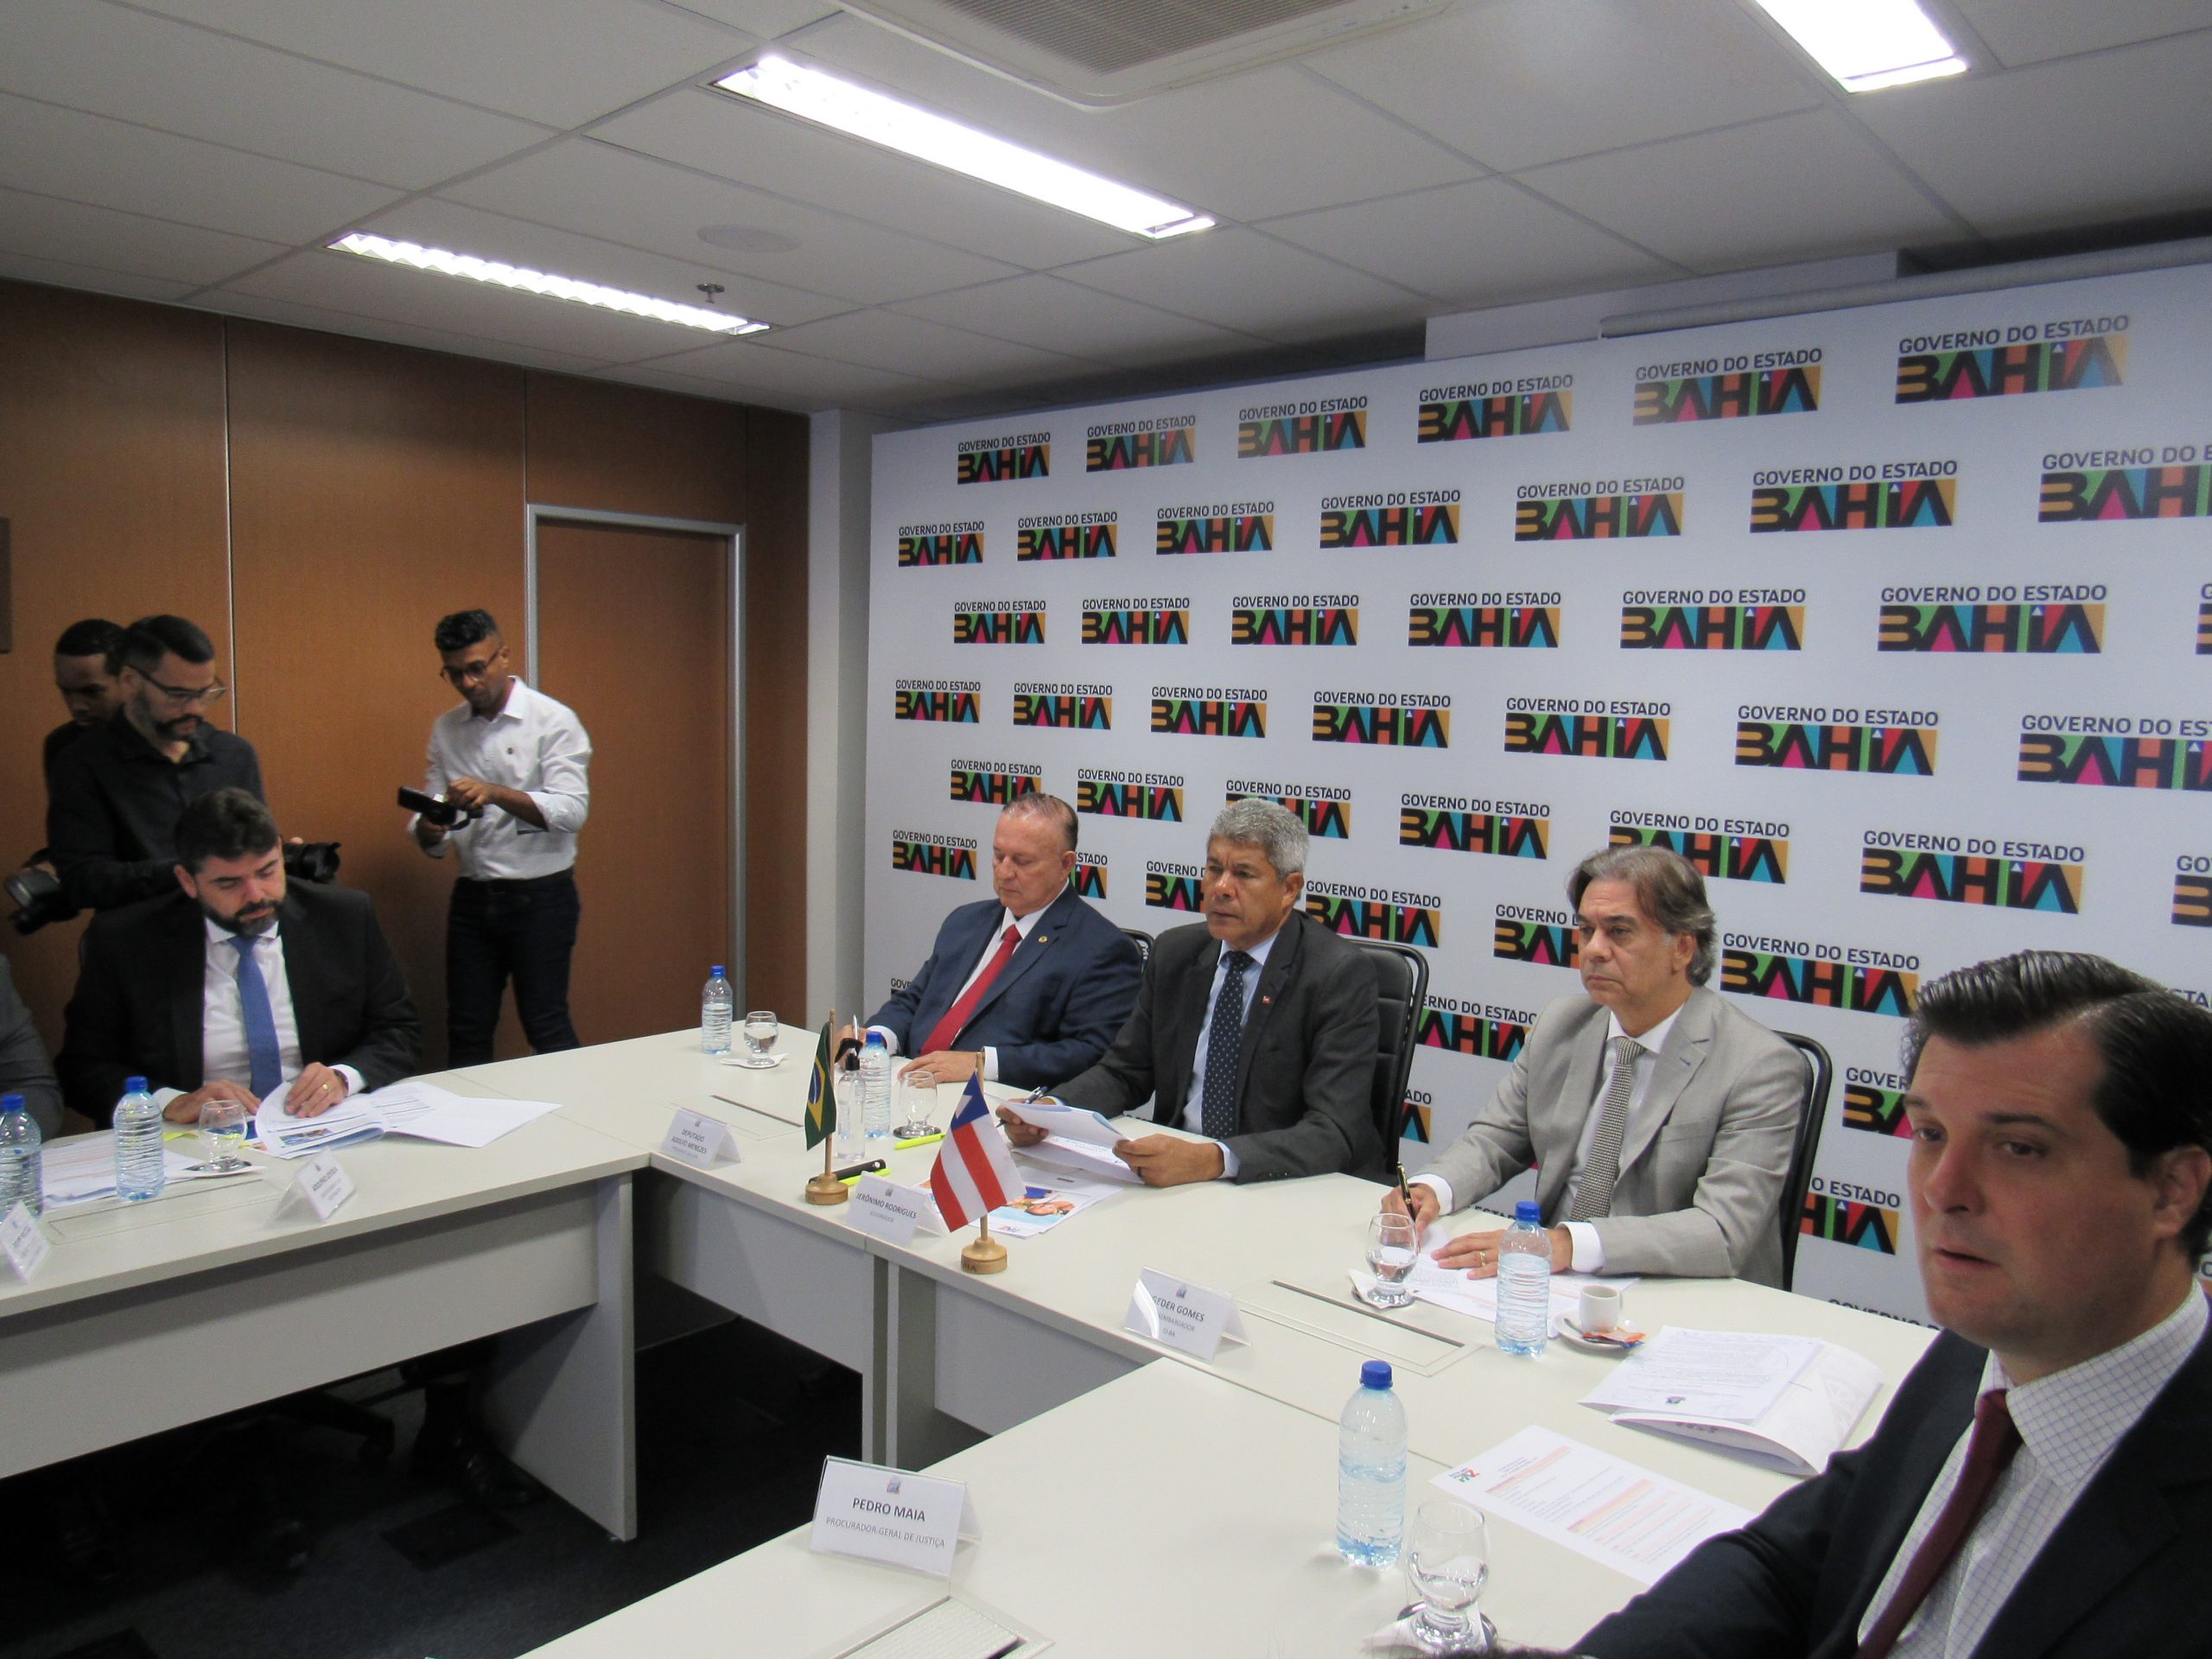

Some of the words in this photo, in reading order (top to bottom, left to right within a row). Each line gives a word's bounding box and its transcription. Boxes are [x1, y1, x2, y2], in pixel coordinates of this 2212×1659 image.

[1897, 327, 2000, 354] GOVERNO
[2005, 323, 2037, 343] DO
[2042, 314, 2129, 340] ESTADO
[1634, 357, 1718, 380] GOVERNO
[1721, 353, 1748, 372] DO
[1751, 346, 1822, 369] ESTADO
[1894, 334, 2127, 404] BAHIA
[1418, 382, 1488, 403] GOVERNO
[1491, 379, 1512, 396] DO
[1516, 372, 1573, 393] ESTADO
[1632, 365, 1821, 425] BAHIA
[1238, 404, 1297, 422] GOVERNO
[1299, 401, 1318, 416] DO
[1319, 395, 1368, 413] ESTADO
[1417, 390, 1573, 444] BAHIA
[1086, 422, 1136, 438] GOVERNO
[1138, 419, 1154, 433] DO
[1155, 415, 1197, 431] ESTADO
[1237, 410, 1368, 460] BAHIA
[957, 437, 1000, 453] GOVERNO
[1001, 435, 1014, 448] DO
[1015, 431, 1051, 446] ESTADO
[1086, 429, 1196, 473] BAHIA
[957, 444, 1051, 485] BAHIA
[1751, 466, 1844, 486] GOVERNO
[1847, 464, 1877, 481] DO
[1881, 459, 1958, 480] ESTADO
[2040, 448, 2155, 471] GOVERNO
[2159, 445, 2196, 464] DO
[1320, 494, 1383, 511] GOVERNO
[1386, 493, 1406, 507] DO
[1408, 489, 1461, 505] ESTADO
[1516, 480, 1592, 499] GOVERNO
[1594, 480, 1618, 495] DO
[1622, 475, 1685, 493] ESTADO
[1017, 515, 1063, 529] GOVERNO
[1065, 513, 1079, 526] DO
[1080, 511, 1118, 524] ESTADO
[1156, 505, 1210, 520] GOVERNO
[1211, 504, 1229, 517] DO
[1230, 501, 1274, 516] ESTADO
[1515, 493, 1684, 542] BAHIA
[1750, 478, 1957, 533] BAHIA
[897, 523, 937, 536] GOVERNO
[938, 522, 950, 533] DO
[952, 520, 984, 532] ESTADO
[1156, 515, 1274, 556] BAHIA
[1319, 505, 1460, 550] BAHIA
[897, 532, 984, 567] BAHIA
[1017, 524, 1117, 562] BAHIA
[953, 601, 995, 612] GOVERNO
[997, 600, 1010, 611] DO
[1012, 600, 1046, 611] ESTADO
[1082, 598, 1131, 610] GOVERNO
[1132, 598, 1148, 609] DO
[1150, 597, 1190, 609] ESTADO
[1231, 595, 1289, 608] GOVERNO
[1292, 594, 1310, 607] DO
[1312, 594, 1360, 607] ESTADO
[1409, 592, 1478, 607] GOVERNO
[1480, 592, 1502, 606] DO
[1505, 591, 1562, 606] ESTADO
[1622, 588, 1705, 604] GOVERNO
[1707, 588, 1734, 604] DO
[1738, 588, 1807, 603] ESTADO
[1879, 585, 1981, 602] GOVERNO
[1986, 585, 2018, 601] DO
[2022, 583, 2107, 601] ESTADO
[953, 612, 1046, 644] BAHIA
[1081, 611, 1190, 645] BAHIA
[1231, 609, 1359, 646] BAHIA
[1408, 607, 1561, 648] BAHIA
[1620, 606, 1806, 650] BAHIA
[1878, 604, 2106, 653] BAHIA
[894, 678, 934, 690] GOVERNO
[935, 679, 947, 690] DO
[949, 680, 981, 691] ESTADO
[1013, 682, 1058, 694] GOVERNO
[1059, 683, 1074, 695] DO
[1076, 683, 1113, 696] ESTADO
[1151, 686, 1204, 699] GOVERNO
[1205, 687, 1222, 700] DO
[1224, 688, 1268, 702] ESTADO
[894, 690, 981, 723] BAHIA
[1013, 694, 1113, 730] BAHIA
[1313, 690, 1375, 705] GOVERNO
[1377, 693, 1397, 706] DO
[1400, 693, 1452, 709] ESTADO
[1505, 696, 1580, 713] GOVERNO
[1582, 699, 1606, 714] DO
[1609, 700, 1671, 716] ESTADO
[1150, 699, 1268, 739] BAHIA
[1312, 705, 1451, 748] BAHIA
[1737, 704, 1827, 722] GOVERNO
[1831, 707, 1859, 724] DO
[1864, 709, 1940, 727] ESTADO
[2020, 714, 2132, 734] GOVERNO
[2137, 717, 2172, 736] DO
[1503, 713, 1670, 761] BAHIA
[1735, 721, 1938, 776] BAHIA
[950, 758, 992, 772] GOVERNO
[993, 761, 1007, 772] DO
[1007, 762, 1042, 776] ESTADO
[1077, 767, 1126, 783] GOVERNO
[1127, 772, 1142, 784] DO
[1144, 772, 1185, 787] ESTADO
[1077, 780, 1184, 823] BAHIA
[1225, 779, 1282, 796] GOVERNO
[1284, 784, 1302, 798] DO
[1304, 785, 1351, 802] ESTADO
[1400, 792, 1467, 811] GOVERNO
[1470, 798, 1491, 813] DO
[1494, 800, 1550, 818] ESTADO
[1399, 808, 1549, 860] BAHIA
[1609, 809, 1690, 830] GOVERNO
[1694, 816, 1719, 832] DO
[1723, 818, 1790, 838] ESTADO
[892, 828, 931, 843] GOVERNO
[932, 833, 944, 845] DO
[945, 835, 977, 849] ESTADO
[1862, 829, 1961, 853] GOVERNO
[1966, 837, 1997, 855] DO
[2001, 840, 2085, 863] ESTADO
[893, 839, 977, 880] BAHIA
[1145, 860, 1198, 878] GOVERNO
[1305, 880, 1366, 899] GOVERNO
[1369, 887, 1388, 902] DO
[1390, 890, 1441, 909] ESTADO
[1859, 847, 2083, 914] BAHIA
[1494, 903, 1567, 925] GOVERNO
[1721, 931, 1810, 957] GOVERNO
[1814, 943, 1842, 962] DO
[1846, 947, 1920, 971] ESTADO
[1719, 949, 1919, 1020] BAHIA
[1459, 1000, 1480, 1016] DO
[1827, 1179, 1900, 1209] ESTADO
[885, 1202, 917, 1219] RODRIGUES
[1176, 1305, 1205, 1323] GOMES
[852, 1497, 891, 1515] PEDRO
[893, 1505, 925, 1522] MAIA
[903, 1532, 914, 1541] DE
[916, 1534, 945, 1549] JUSTIÇA
